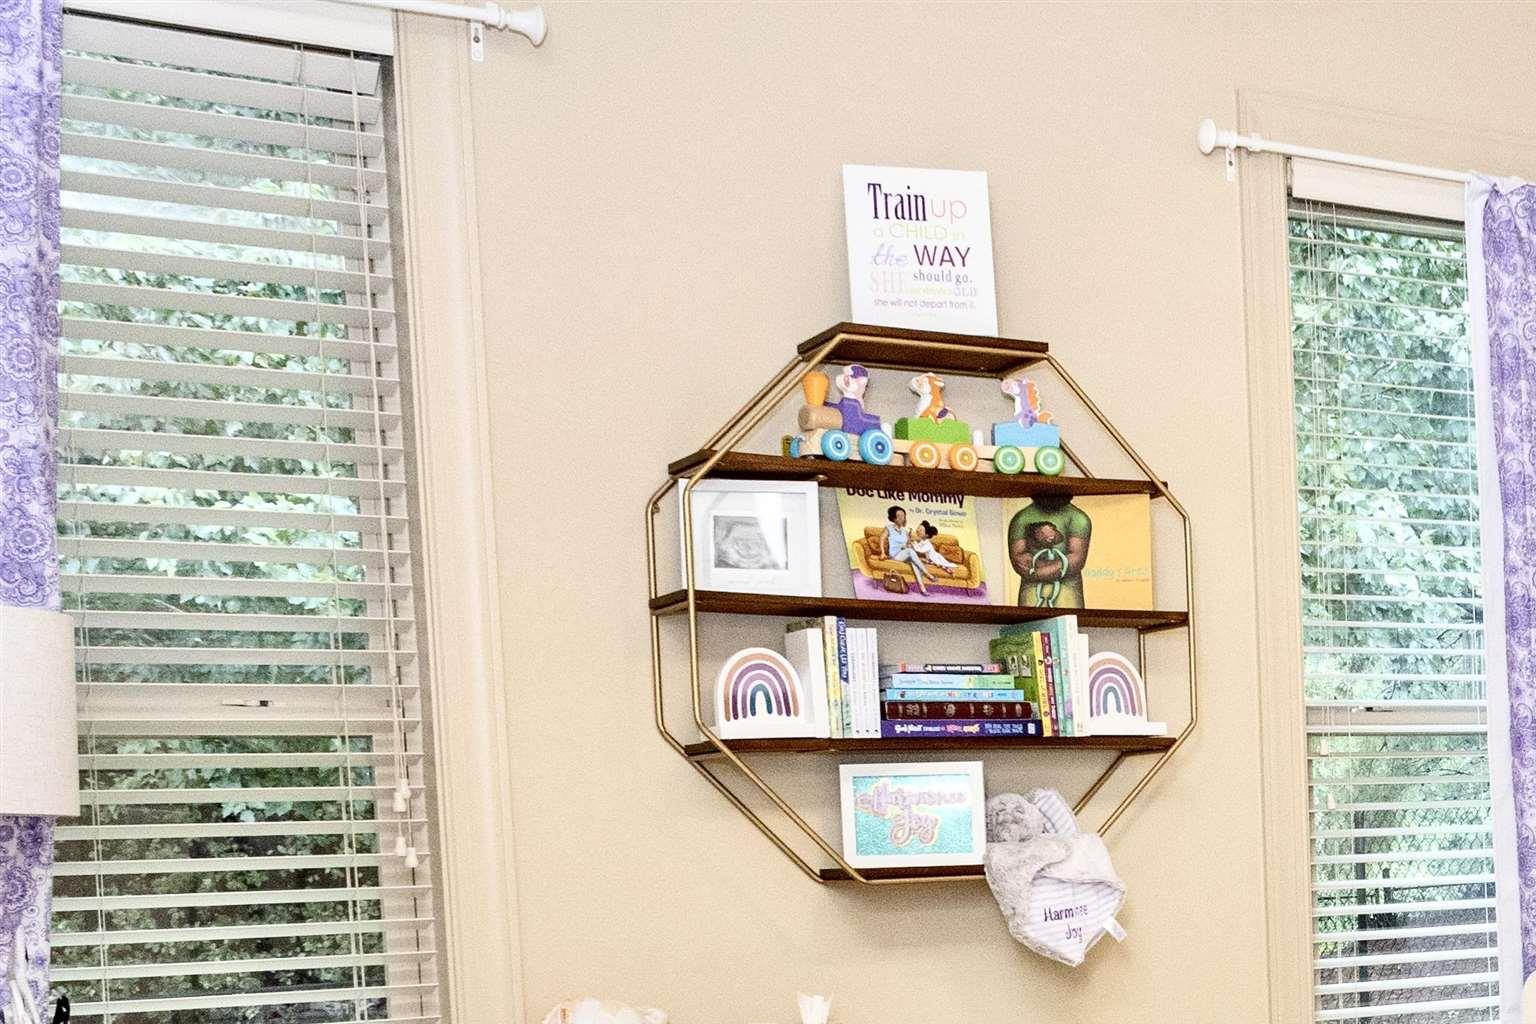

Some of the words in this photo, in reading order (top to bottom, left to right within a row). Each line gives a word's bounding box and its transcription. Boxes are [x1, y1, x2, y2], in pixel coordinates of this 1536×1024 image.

[867, 182, 928, 222] Train
[930, 199, 967, 224] up
[870, 242, 909, 268] the
[913, 243, 971, 268] WAY
[913, 269, 952, 283] should
[908, 492, 965, 509] Mommy
[1065, 924, 1082, 943] Joy
